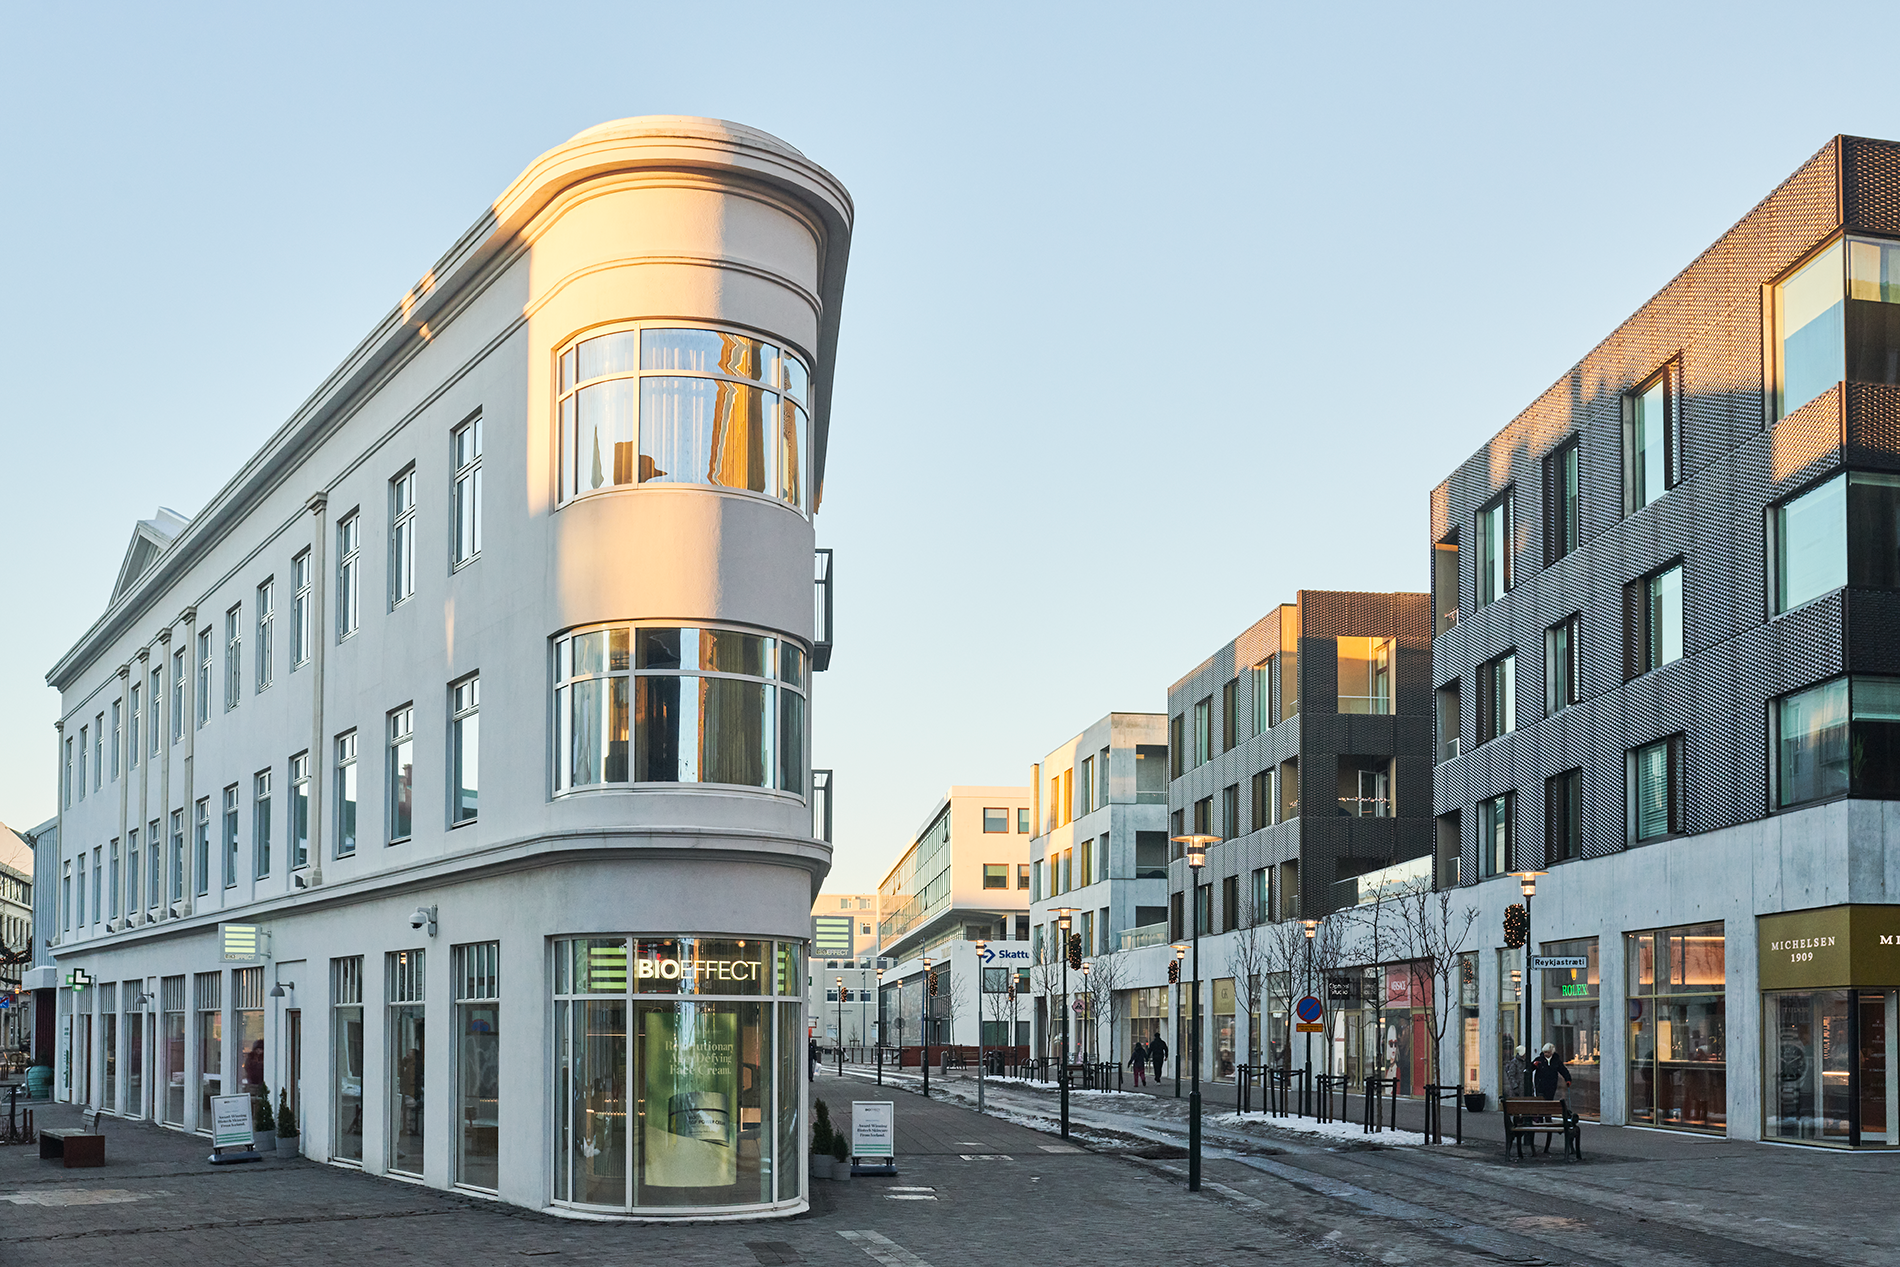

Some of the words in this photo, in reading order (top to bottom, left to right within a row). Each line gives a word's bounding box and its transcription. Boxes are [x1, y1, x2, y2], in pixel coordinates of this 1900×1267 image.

[1771, 936, 1836, 951] MICHELSEN
[1535, 958, 1585, 966] Reykjastræti
[1791, 952, 1814, 963] 1909
[638, 959, 762, 981] BIOEFFECT
[1562, 984, 1589, 997] ROLEX
[664, 1040, 734, 1054] Rlutionary
[697, 1064, 732, 1075] Cream.
